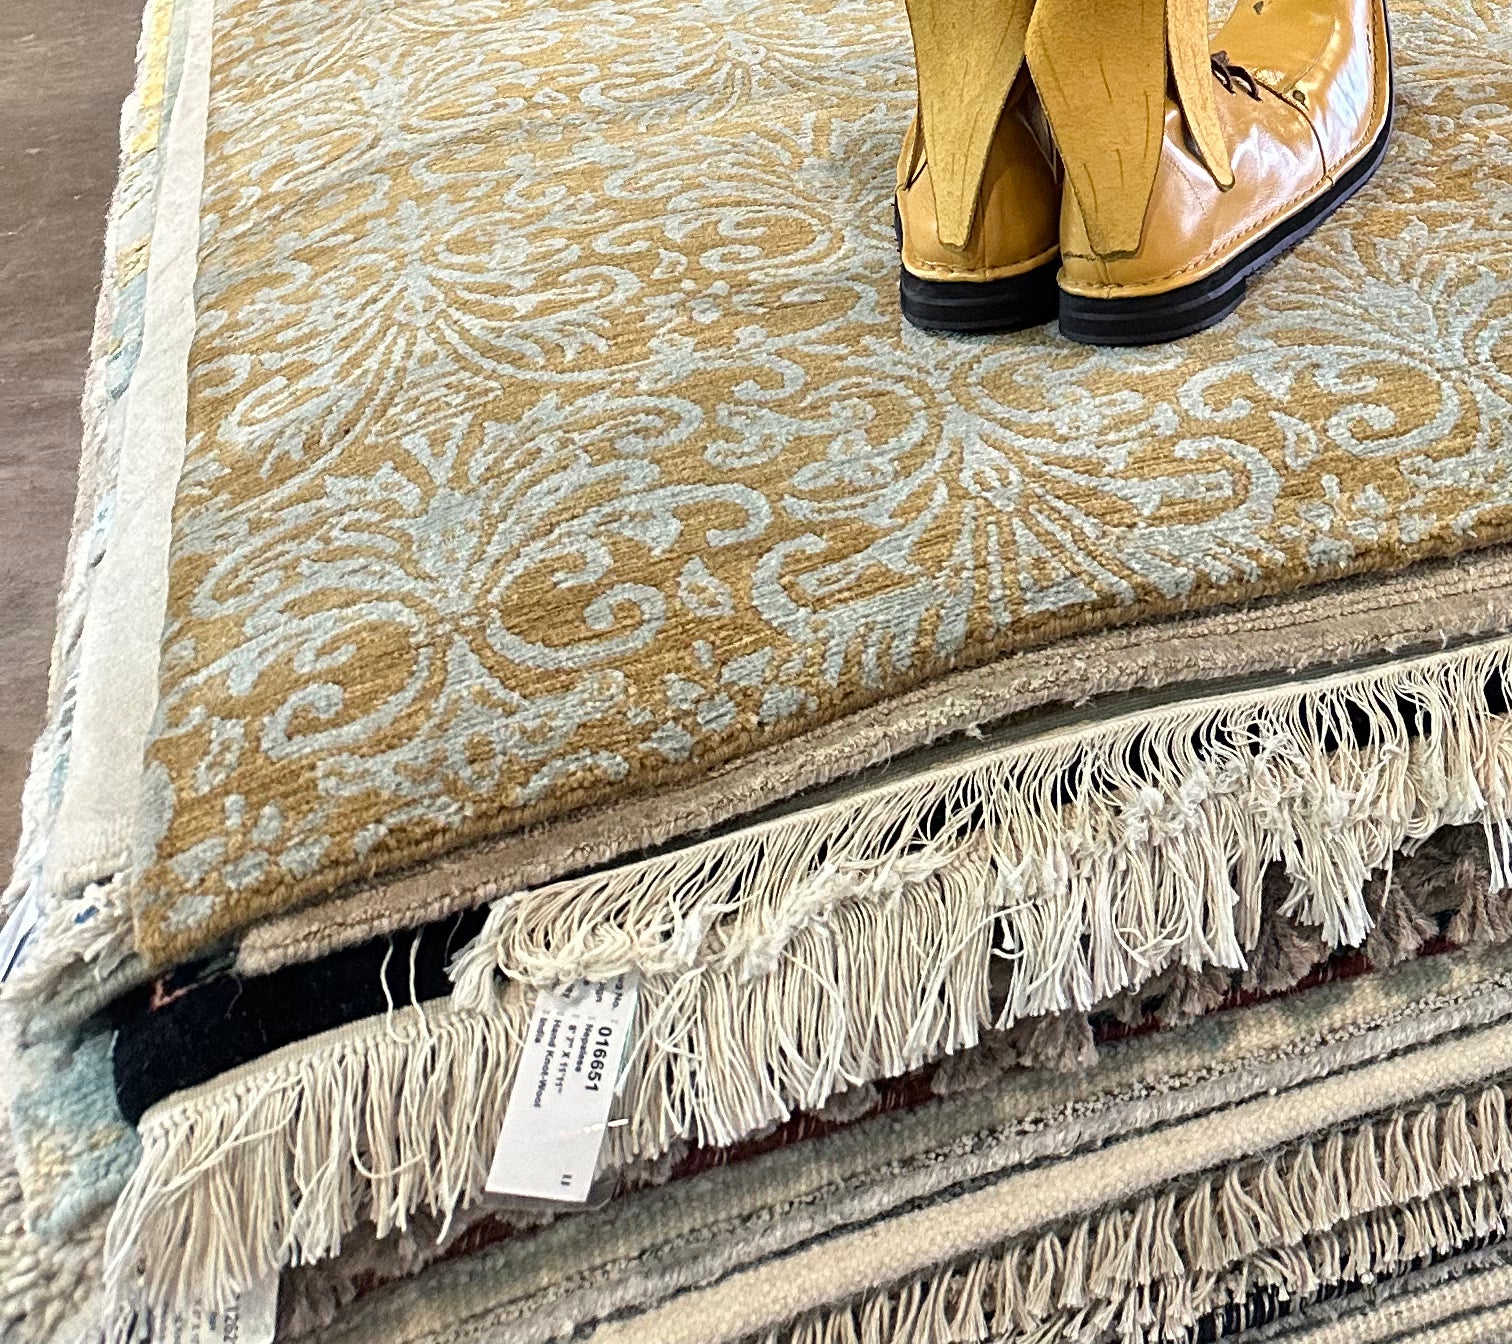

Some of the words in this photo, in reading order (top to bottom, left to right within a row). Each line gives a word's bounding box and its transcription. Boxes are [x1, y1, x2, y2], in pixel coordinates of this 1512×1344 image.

[534, 1017, 549, 1043] India
[548, 1019, 562, 1048] Hand
[575, 1023, 594, 1072] Nepalese
[584, 1026, 613, 1092] 016651
